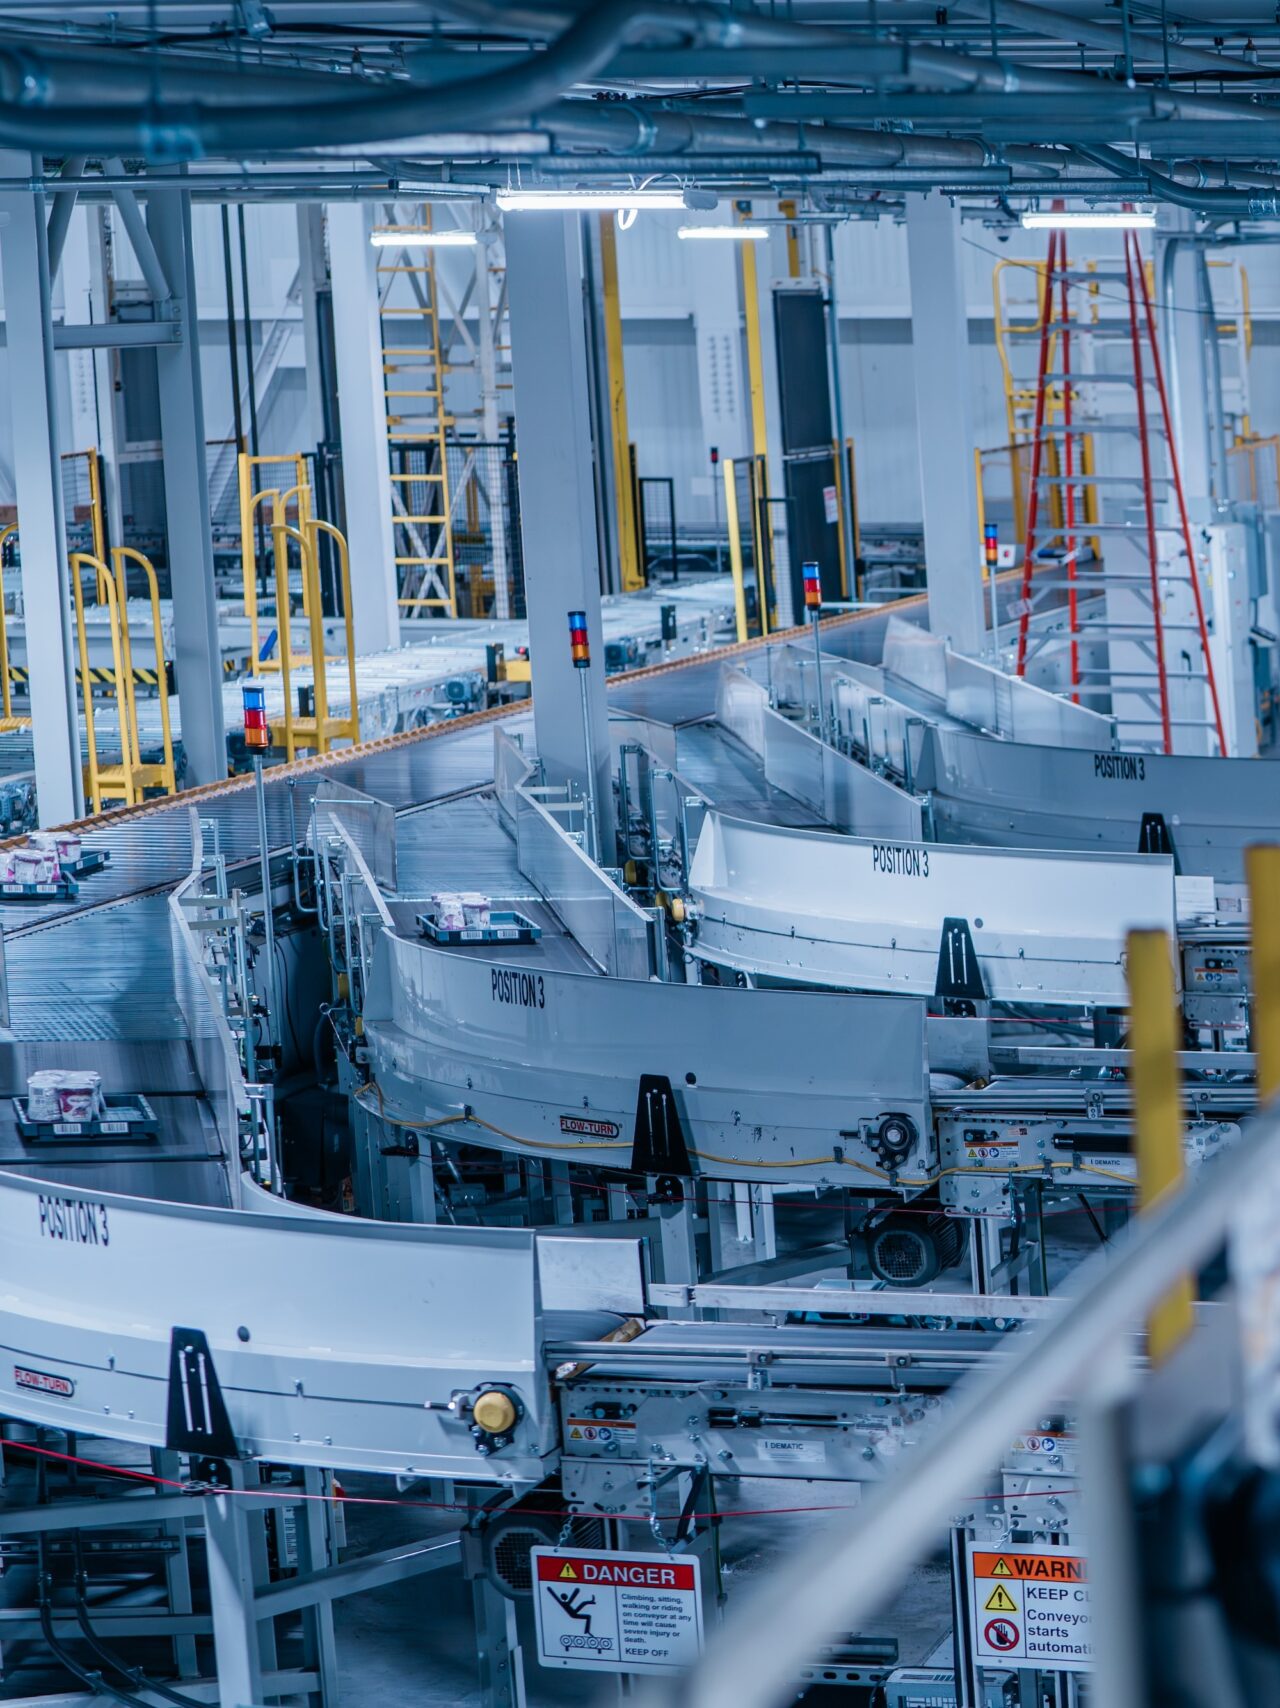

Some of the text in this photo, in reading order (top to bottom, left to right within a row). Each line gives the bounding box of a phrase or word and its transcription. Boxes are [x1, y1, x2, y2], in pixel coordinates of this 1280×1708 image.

[1094, 753, 1145, 781] POSITION 3
[873, 844, 929, 878] POSITION 3
[491, 967, 545, 1009] POSITION 3
[560, 1119, 614, 1135] FLOW-TURN
[38, 1194, 109, 1247] POSITION 3
[15, 1369, 69, 1393] FLOW-TURN
[770, 1442, 804, 1450] DEMATIC
[583, 1564, 676, 1585] DANGER
[1013, 1558, 1087, 1578] WARN
[1026, 1587, 1069, 1600] KEEP
[622, 1603, 650, 1611] walking
[661, 1605, 683, 1613] riding
[633, 1612, 668, 1620] conveyor
[650, 1629, 671, 1638] injury
[1027, 1626, 1069, 1638] starts
[625, 1647, 669, 1657] KEEP OFF
[1028, 1641, 1094, 1655] automati
